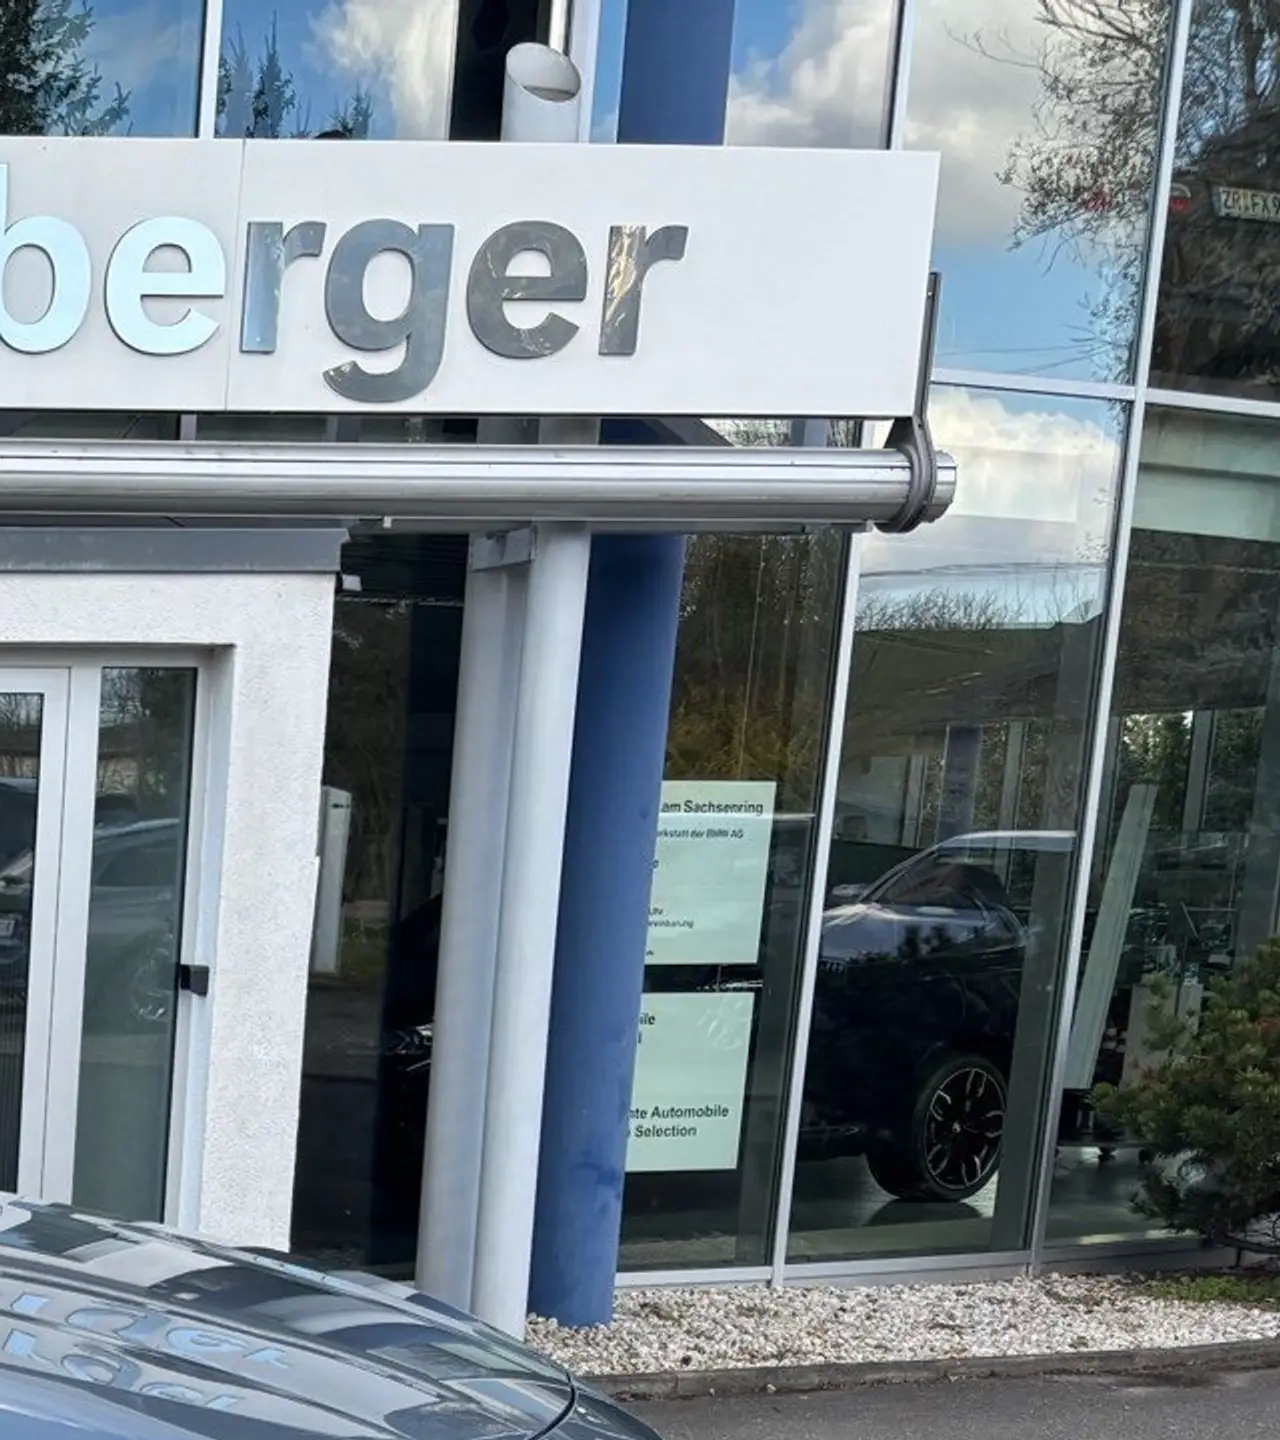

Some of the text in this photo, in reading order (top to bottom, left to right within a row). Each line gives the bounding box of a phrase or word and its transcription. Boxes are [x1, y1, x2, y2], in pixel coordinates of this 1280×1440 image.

[683, 799, 764, 816] Sachsenring
[650, 1103, 730, 1120] Automobile
[634, 1124, 698, 1138] Selection
